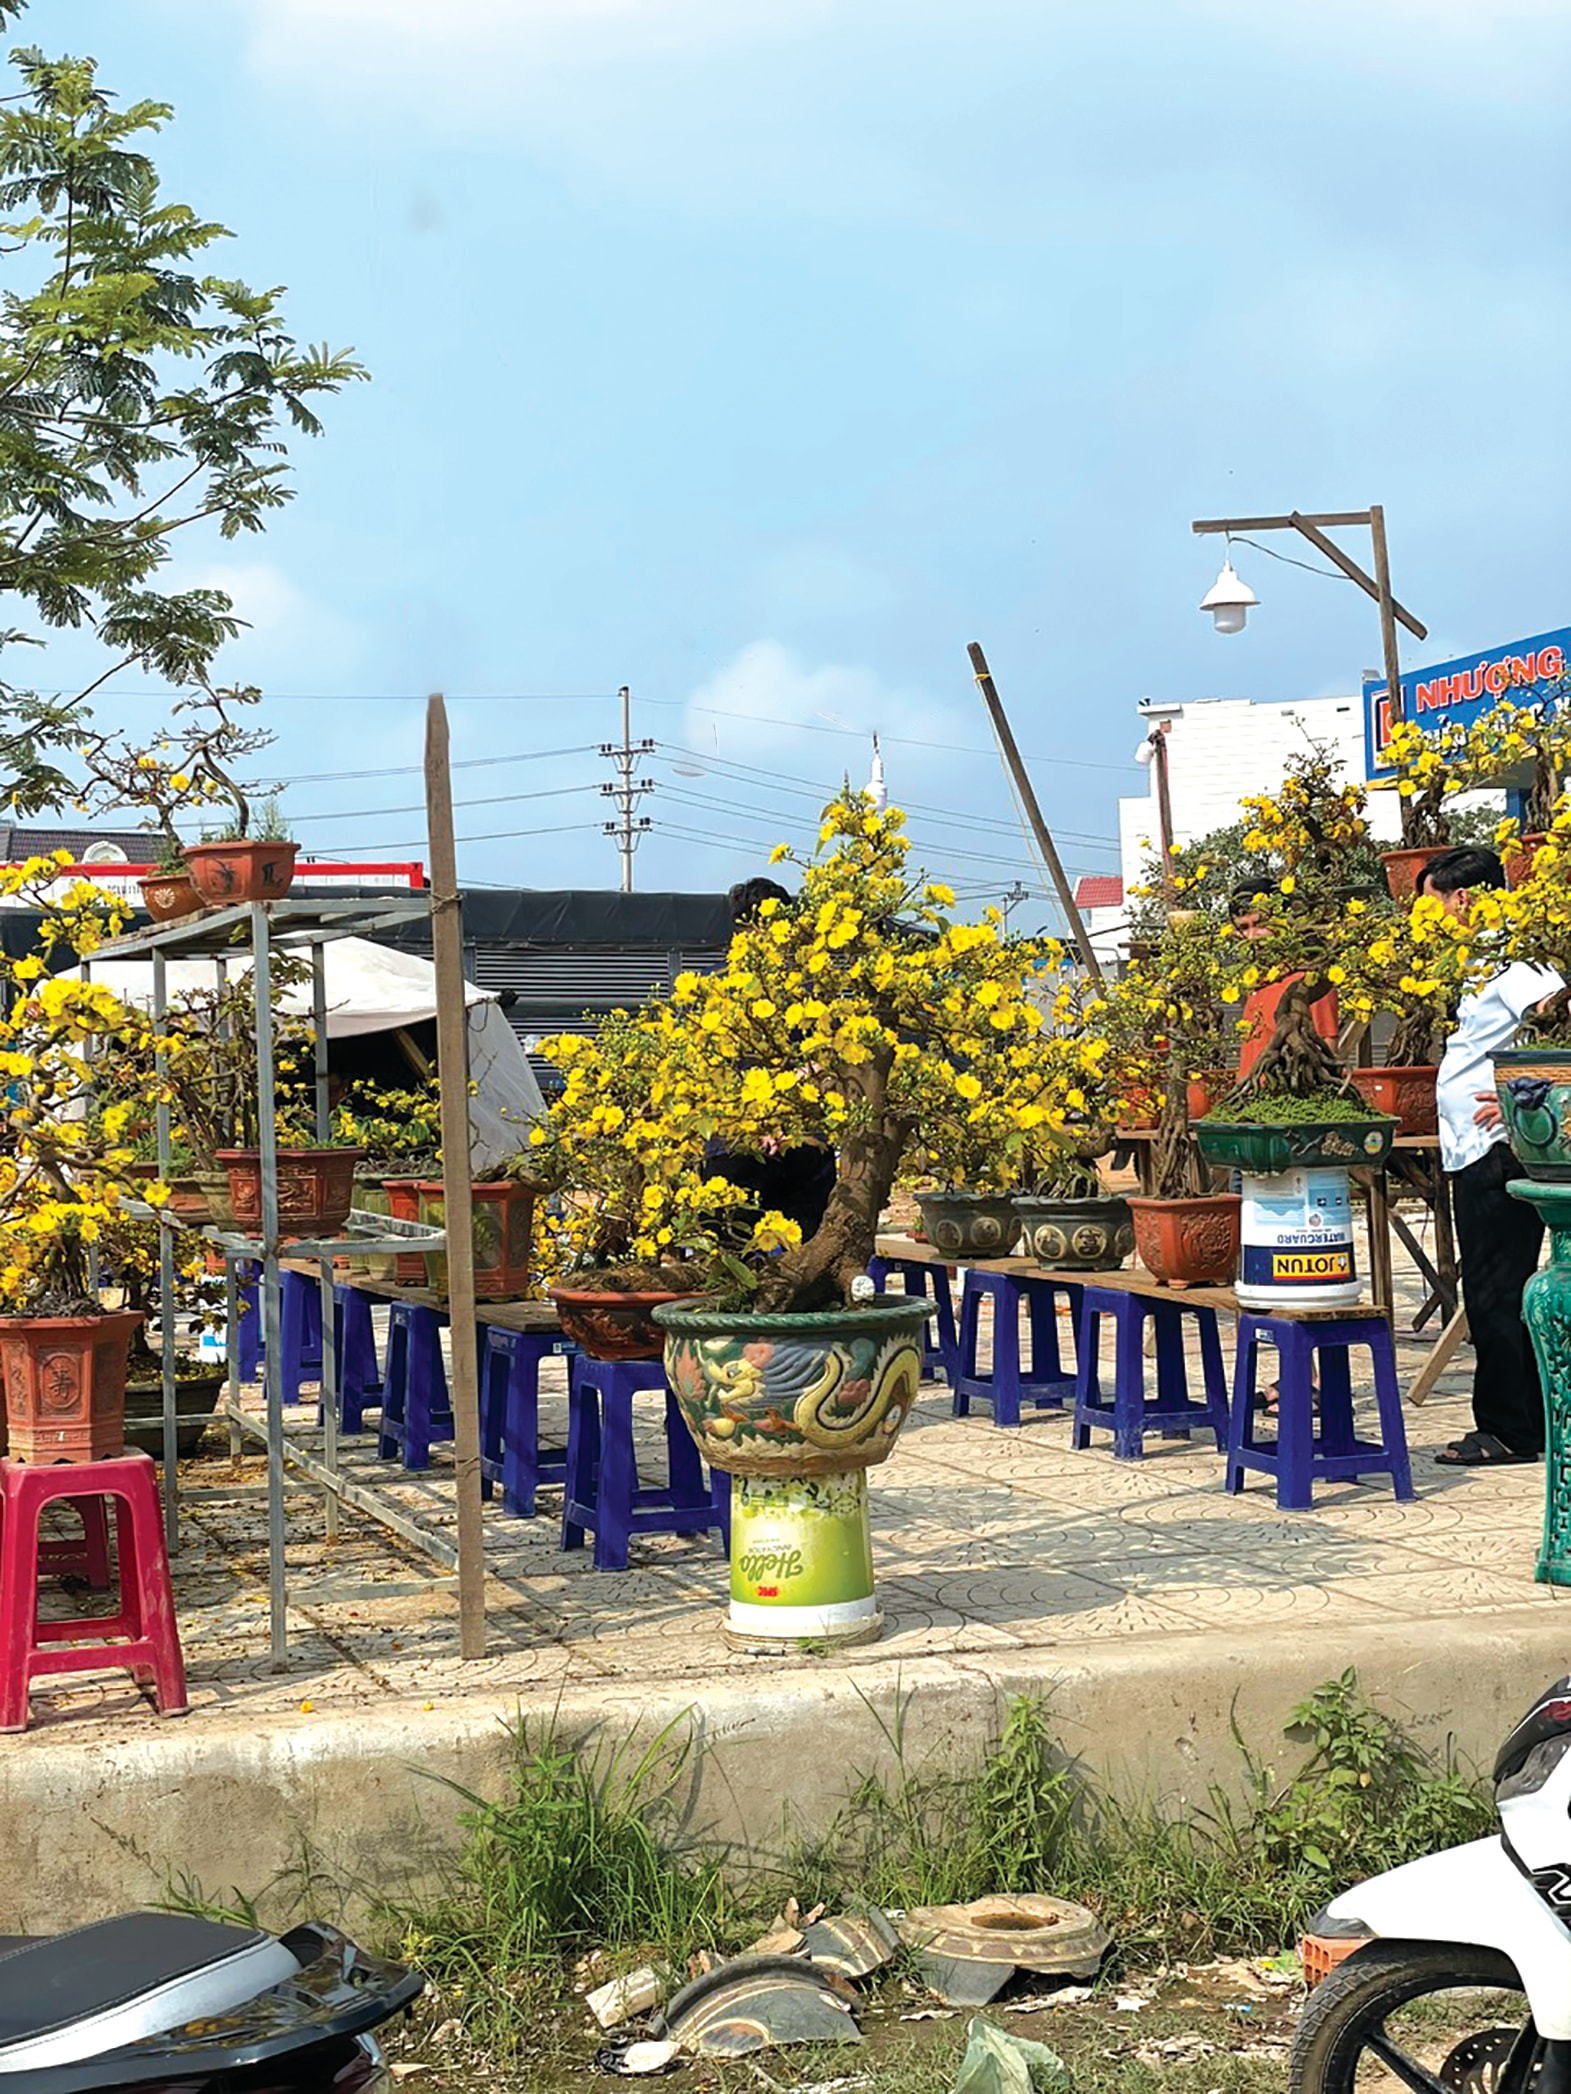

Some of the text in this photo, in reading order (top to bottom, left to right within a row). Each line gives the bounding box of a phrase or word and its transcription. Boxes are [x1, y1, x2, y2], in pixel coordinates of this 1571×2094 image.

[1416, 646, 1562, 713] NHƯỢNG
[1276, 1257, 1335, 1273] JOTUN
[739, 1550, 804, 1582] Hello
